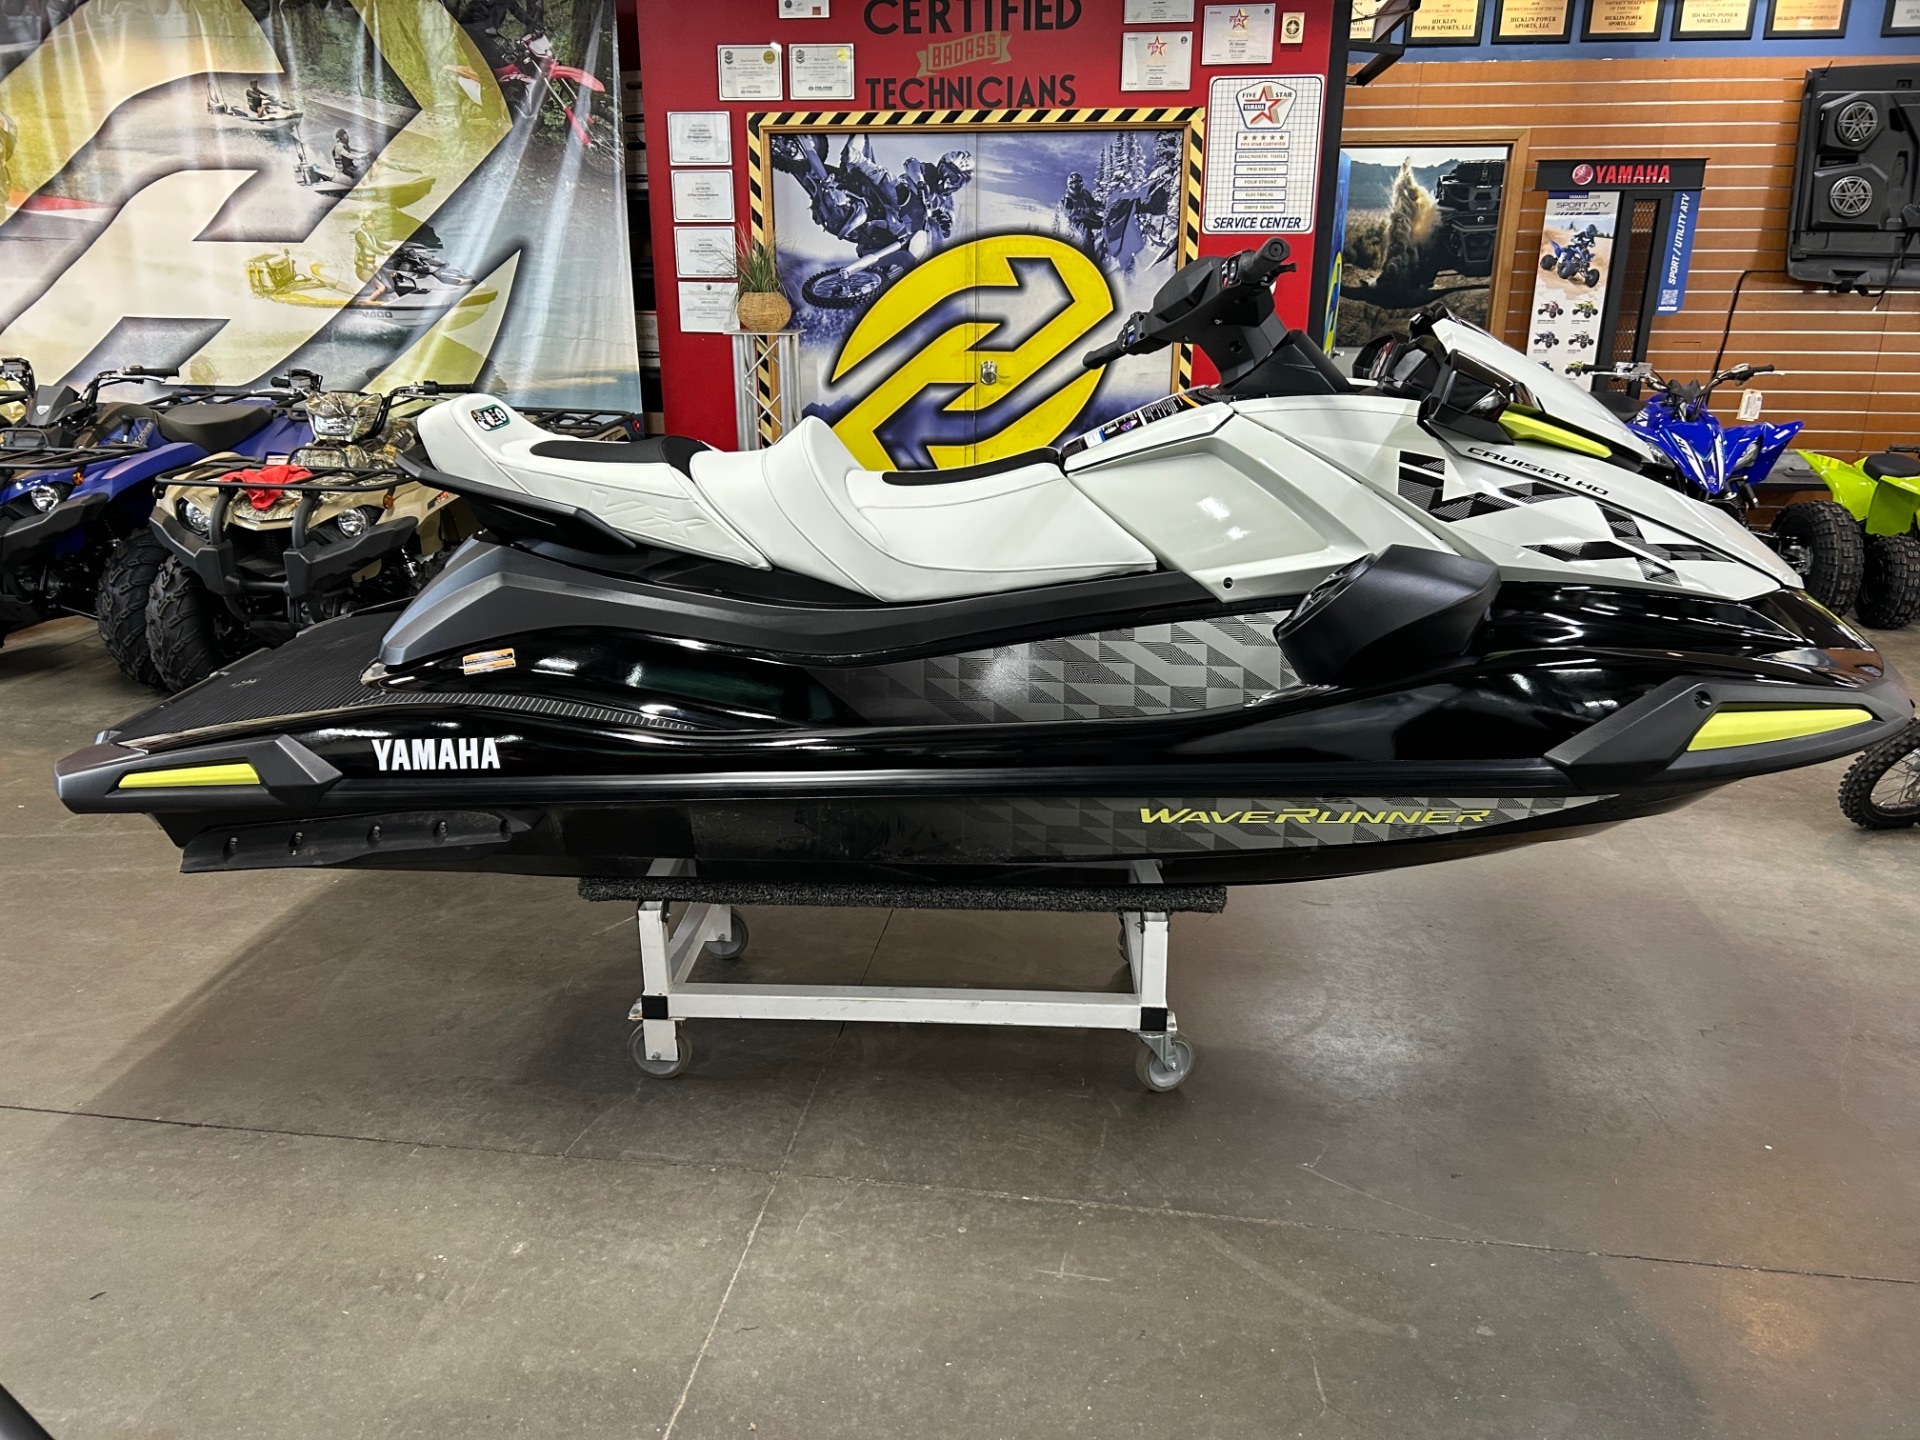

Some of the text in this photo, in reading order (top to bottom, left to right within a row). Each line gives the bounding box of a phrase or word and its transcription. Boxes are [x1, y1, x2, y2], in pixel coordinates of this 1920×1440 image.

[864, 0, 1082, 35] CERTIFIED
[932, 33, 996, 67] BADASS
[865, 74, 1077, 109] TECHNICIANS
[1595, 165, 1670, 184] YAMAHA
[1556, 201, 1588, 209] SPORT
[1213, 217, 1301, 229] SERVICE CENTER
[1668, 193, 1690, 285] SPORT / UTILITY ATV
[1467, 447, 1609, 496] CRUISER HO
[371, 737, 501, 771] YAMAHA
